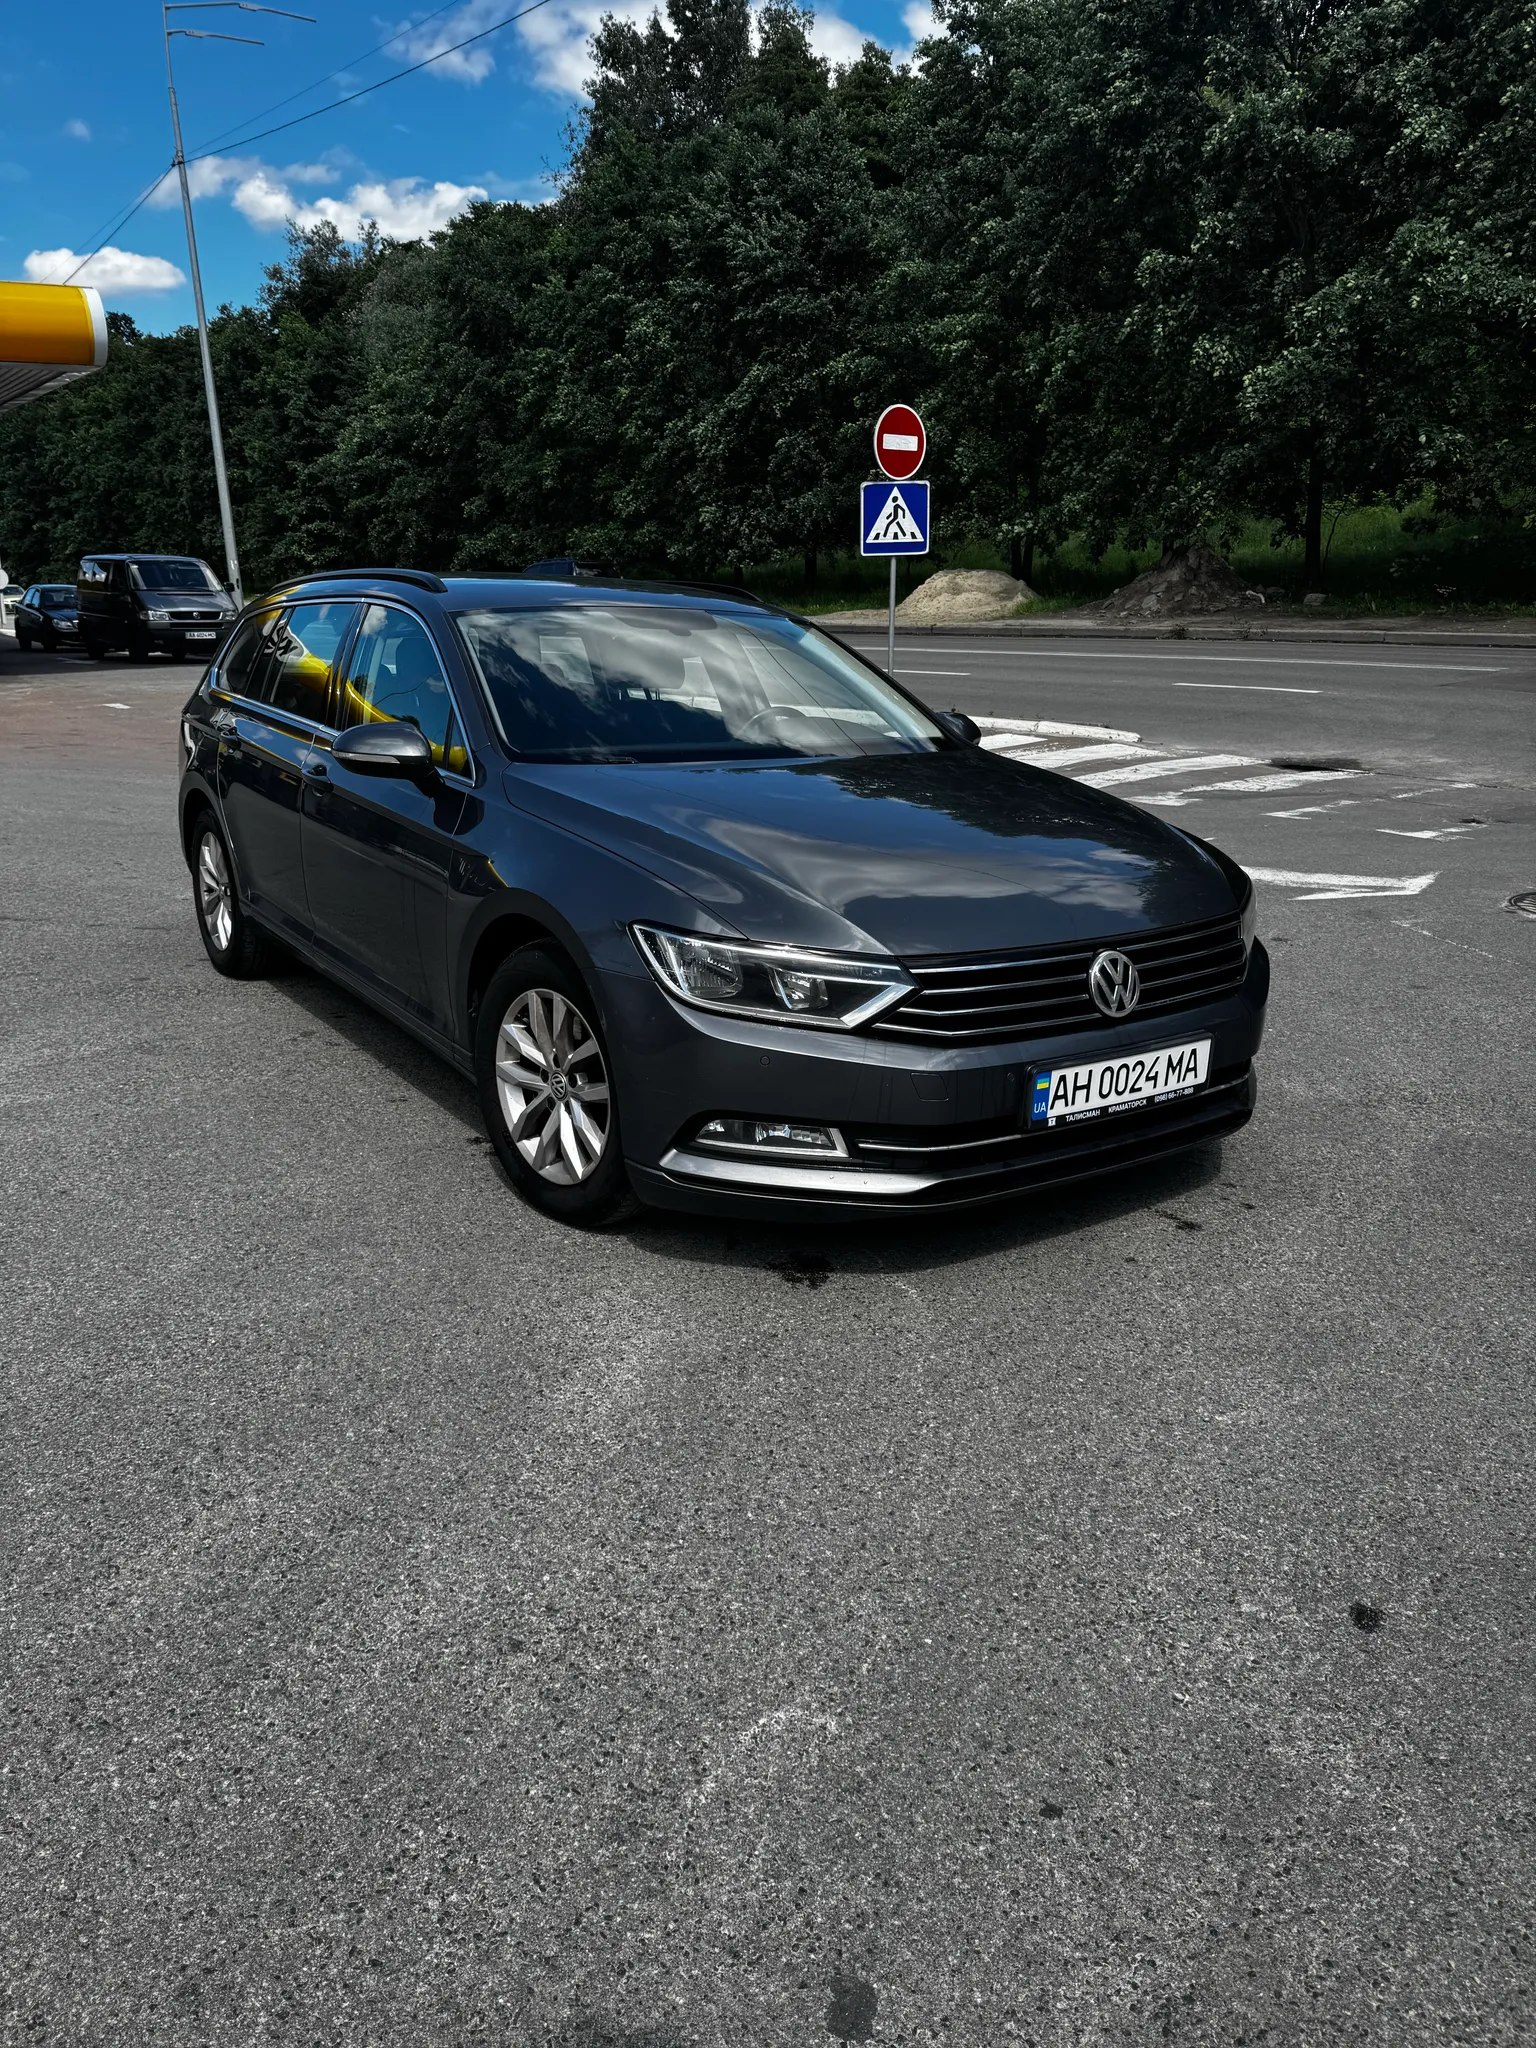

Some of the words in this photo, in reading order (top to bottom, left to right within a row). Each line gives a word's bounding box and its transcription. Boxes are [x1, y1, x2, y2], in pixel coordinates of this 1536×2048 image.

[1049, 1069, 1093, 1110] AH
[1098, 1056, 1160, 1099] 0024
[1163, 1048, 1198, 1086] MA
[1033, 1103, 1047, 1114] UA
[1065, 1109, 1100, 1122] ТАЛИСМАН
[1108, 1099, 1147, 1113] КРАМАТОРСК
